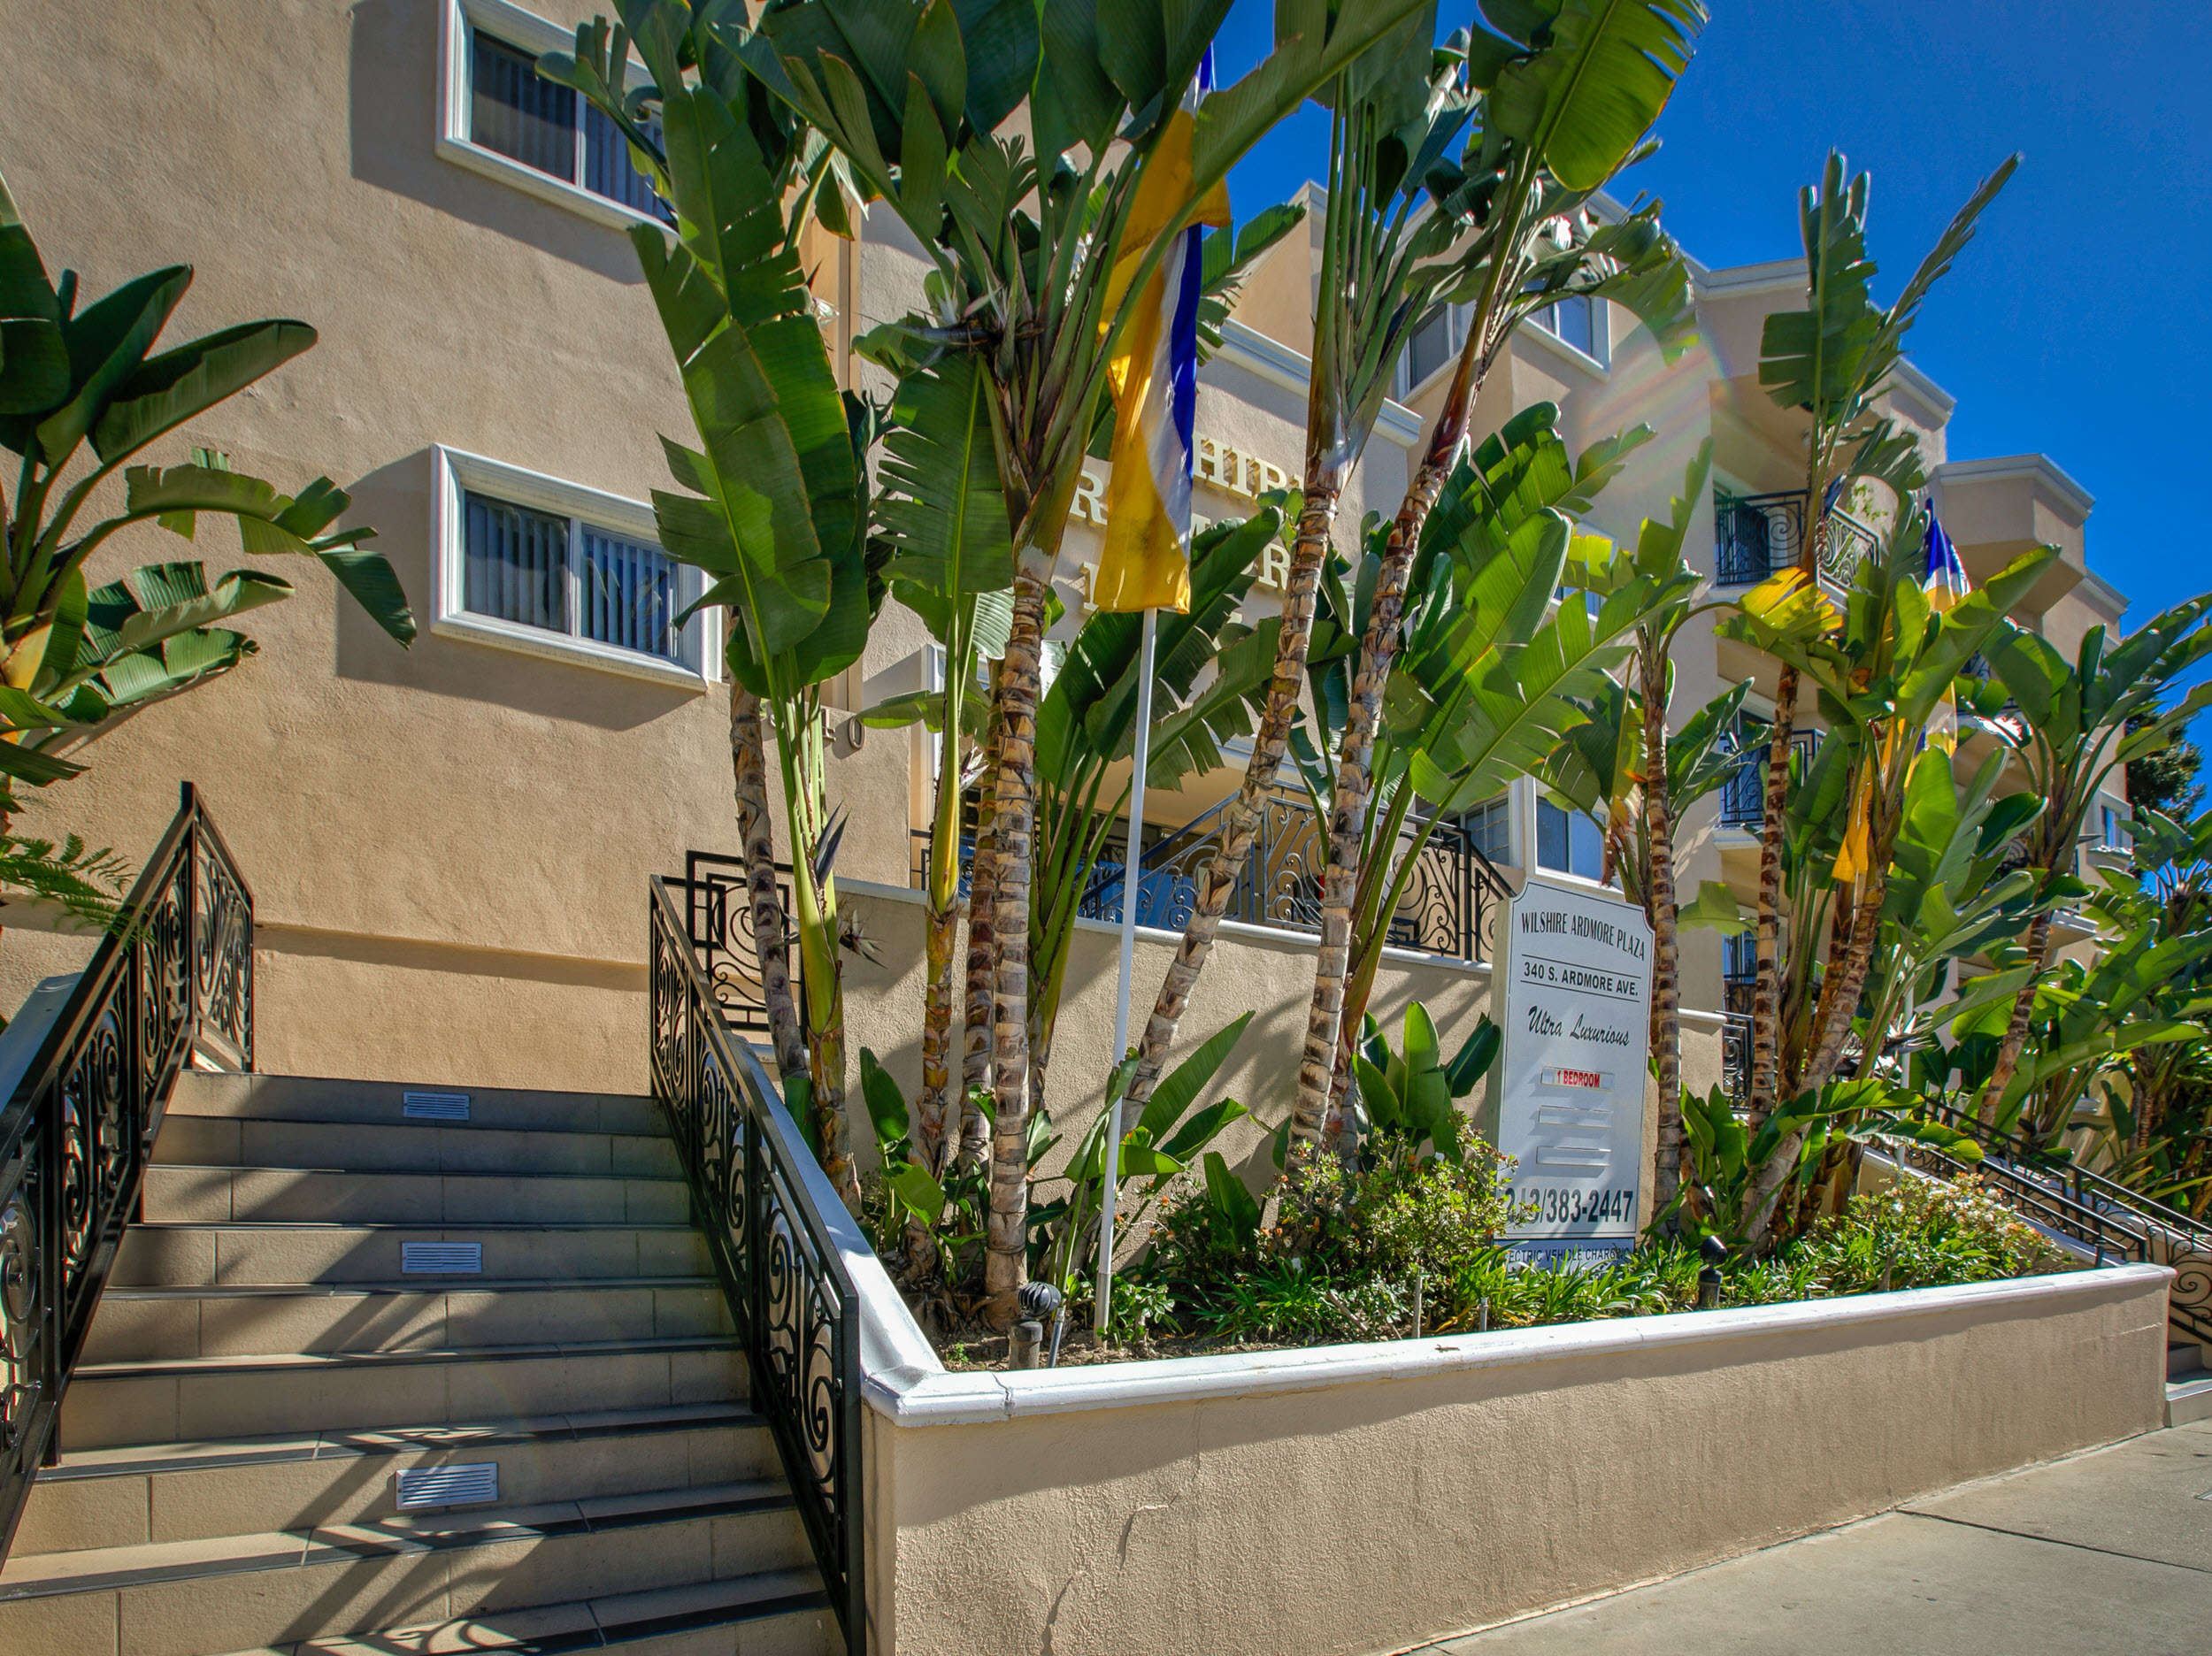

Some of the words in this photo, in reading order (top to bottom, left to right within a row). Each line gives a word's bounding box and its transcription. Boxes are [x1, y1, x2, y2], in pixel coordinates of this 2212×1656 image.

[1521, 911, 1568, 934] WILSHIRE
[1570, 914, 1615, 947] ARDMORE
[1617, 928, 1646, 962] PLAZA
[1524, 961, 1545, 979] 340
[1548, 966, 1558, 982] S.
[1561, 969, 1613, 992] ARDMORE
[1616, 979, 1639, 996] AVE.
[1528, 1005, 1563, 1037] Ultra
[1569, 1012, 1630, 1046] Luxurious
[1557, 1070, 1562, 1084] 1
[1563, 1070, 1601, 1088] BEDROOM
[1507, 1249, 1542, 1262] ECTRIC
